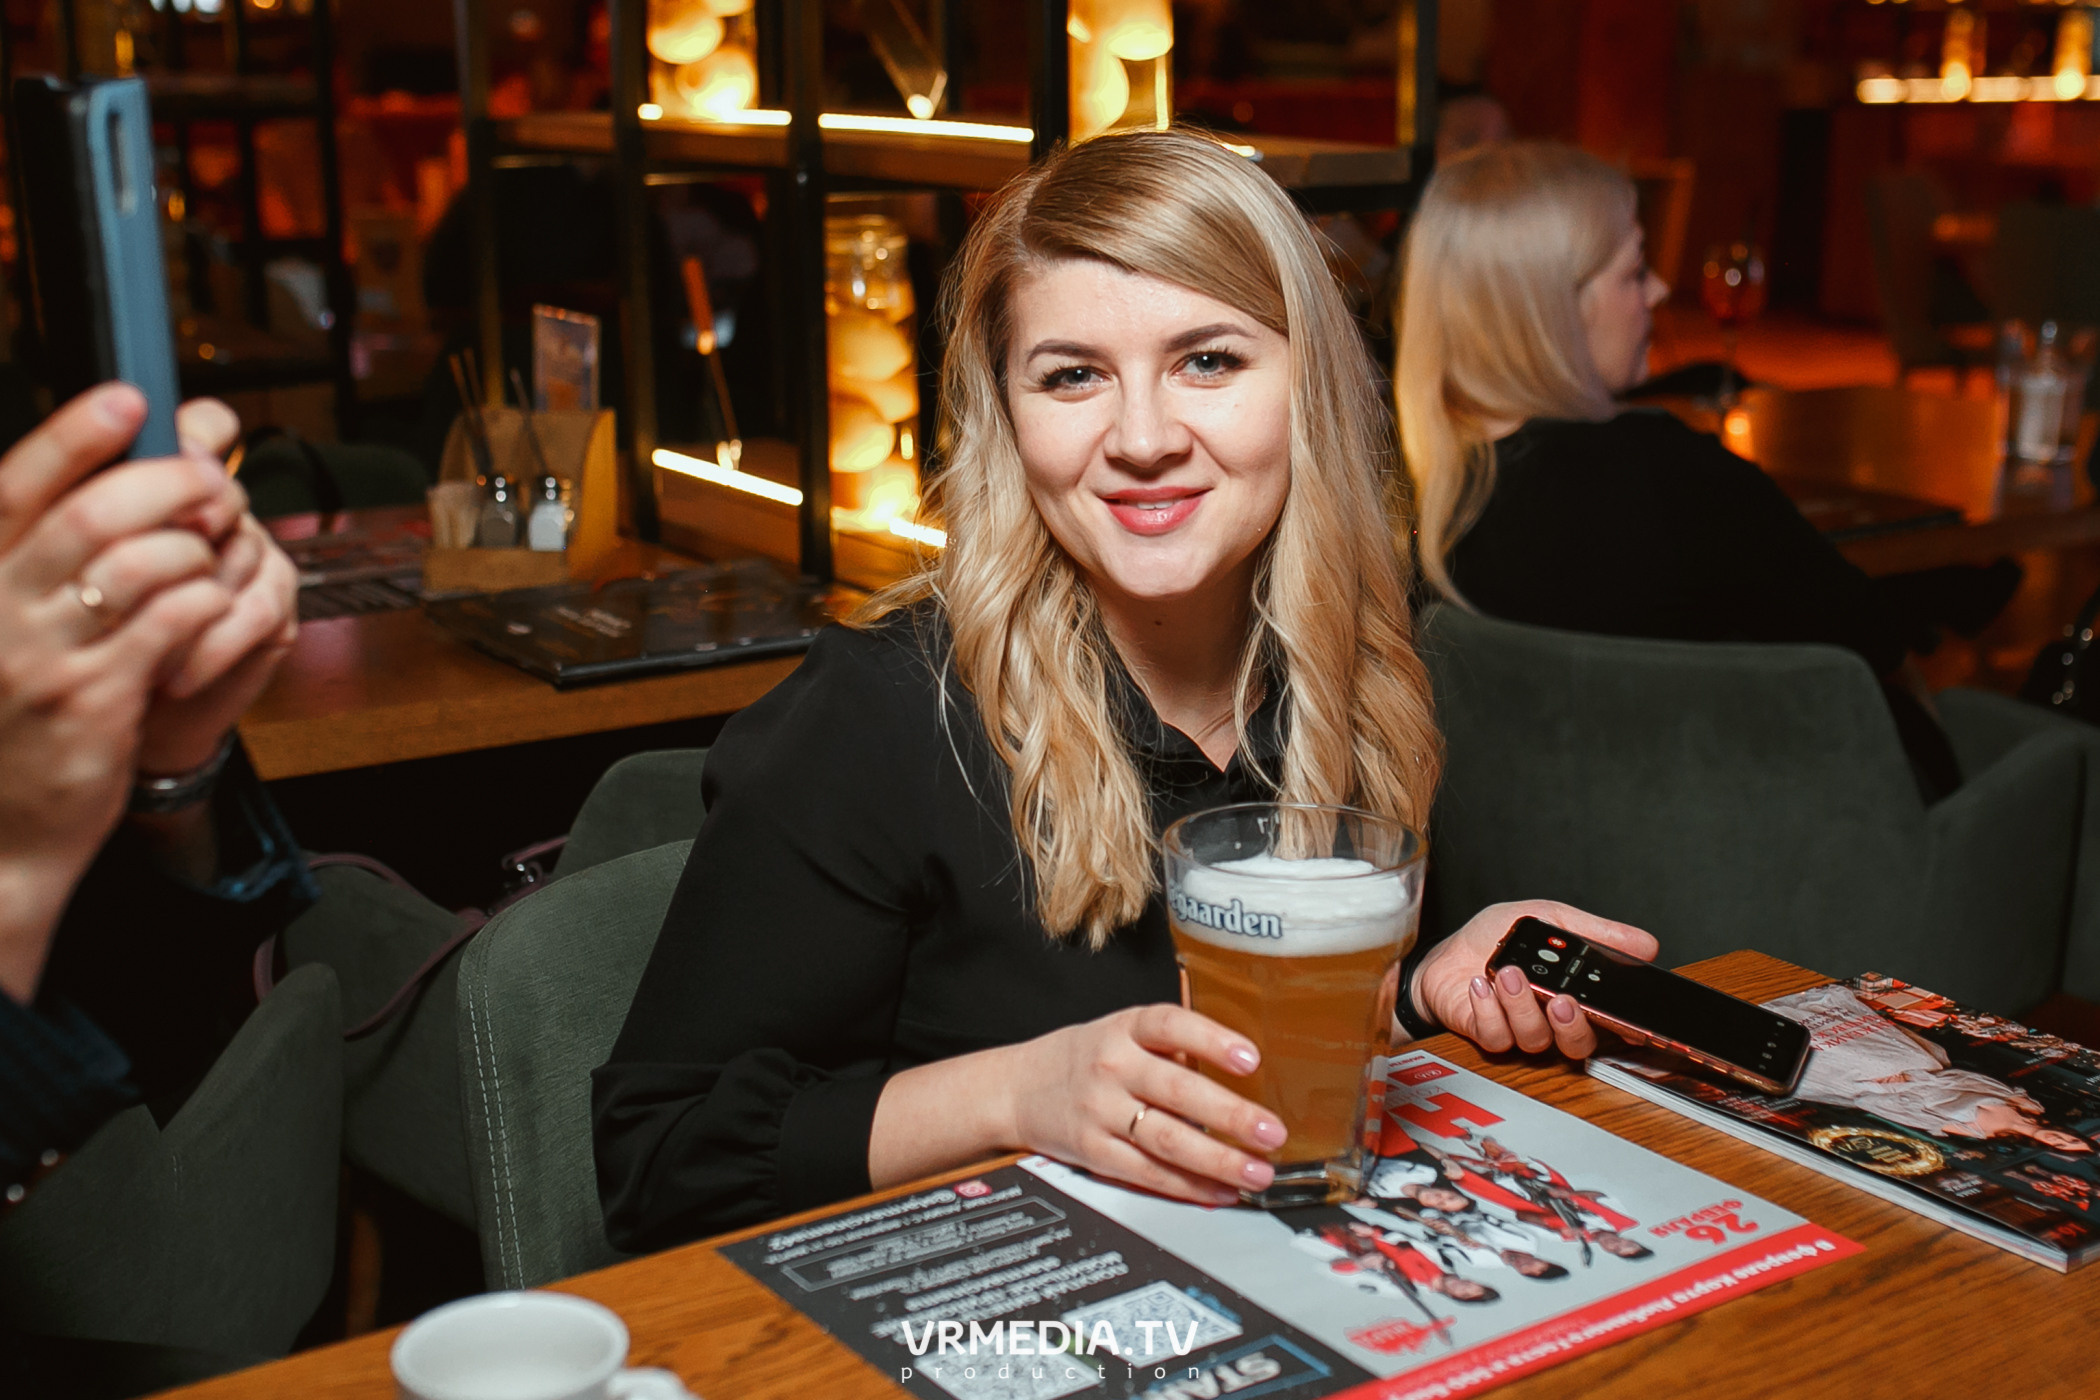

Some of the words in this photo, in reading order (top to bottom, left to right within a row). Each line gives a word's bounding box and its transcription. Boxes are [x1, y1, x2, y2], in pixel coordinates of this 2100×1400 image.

[1168, 886, 1283, 940] gaarden
[1648, 1198, 1744, 1239] ФЕВРАЛЯ
[1691, 1213, 1760, 1246] 26
